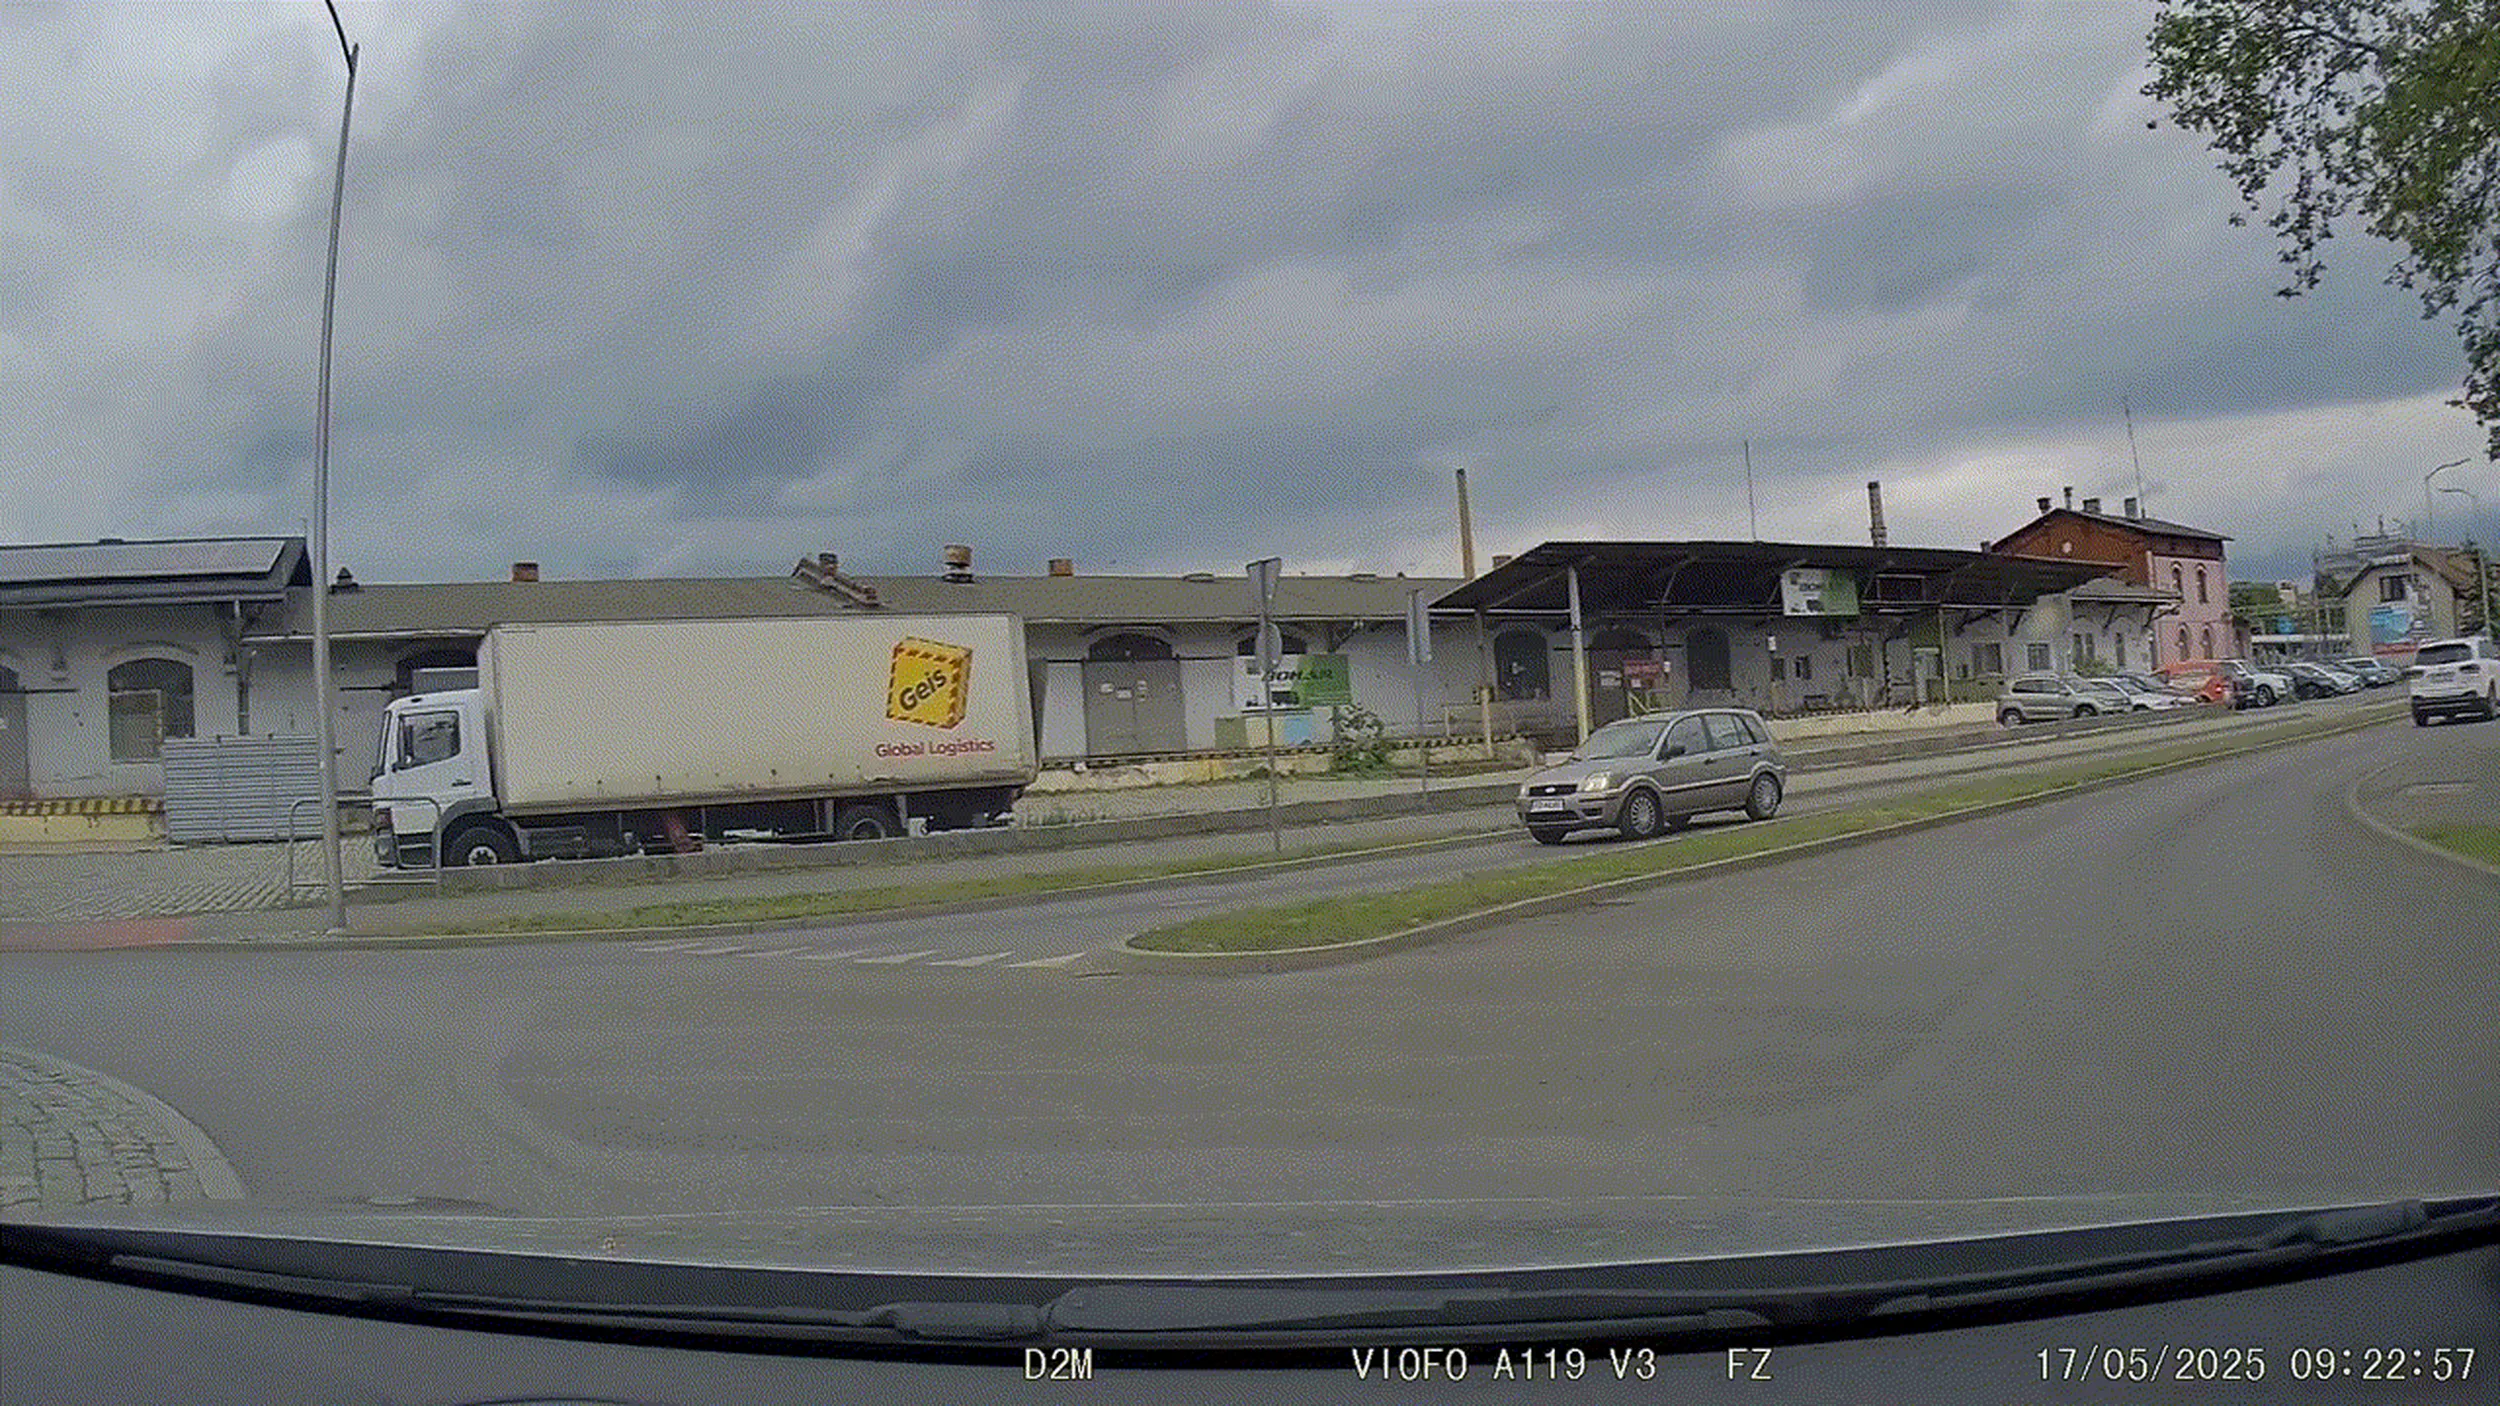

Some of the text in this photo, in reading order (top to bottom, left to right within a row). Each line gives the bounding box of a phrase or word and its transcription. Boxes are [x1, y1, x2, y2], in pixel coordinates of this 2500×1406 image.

[899, 667, 947, 712] Geis
[875, 738, 995, 758] Global Logistics
